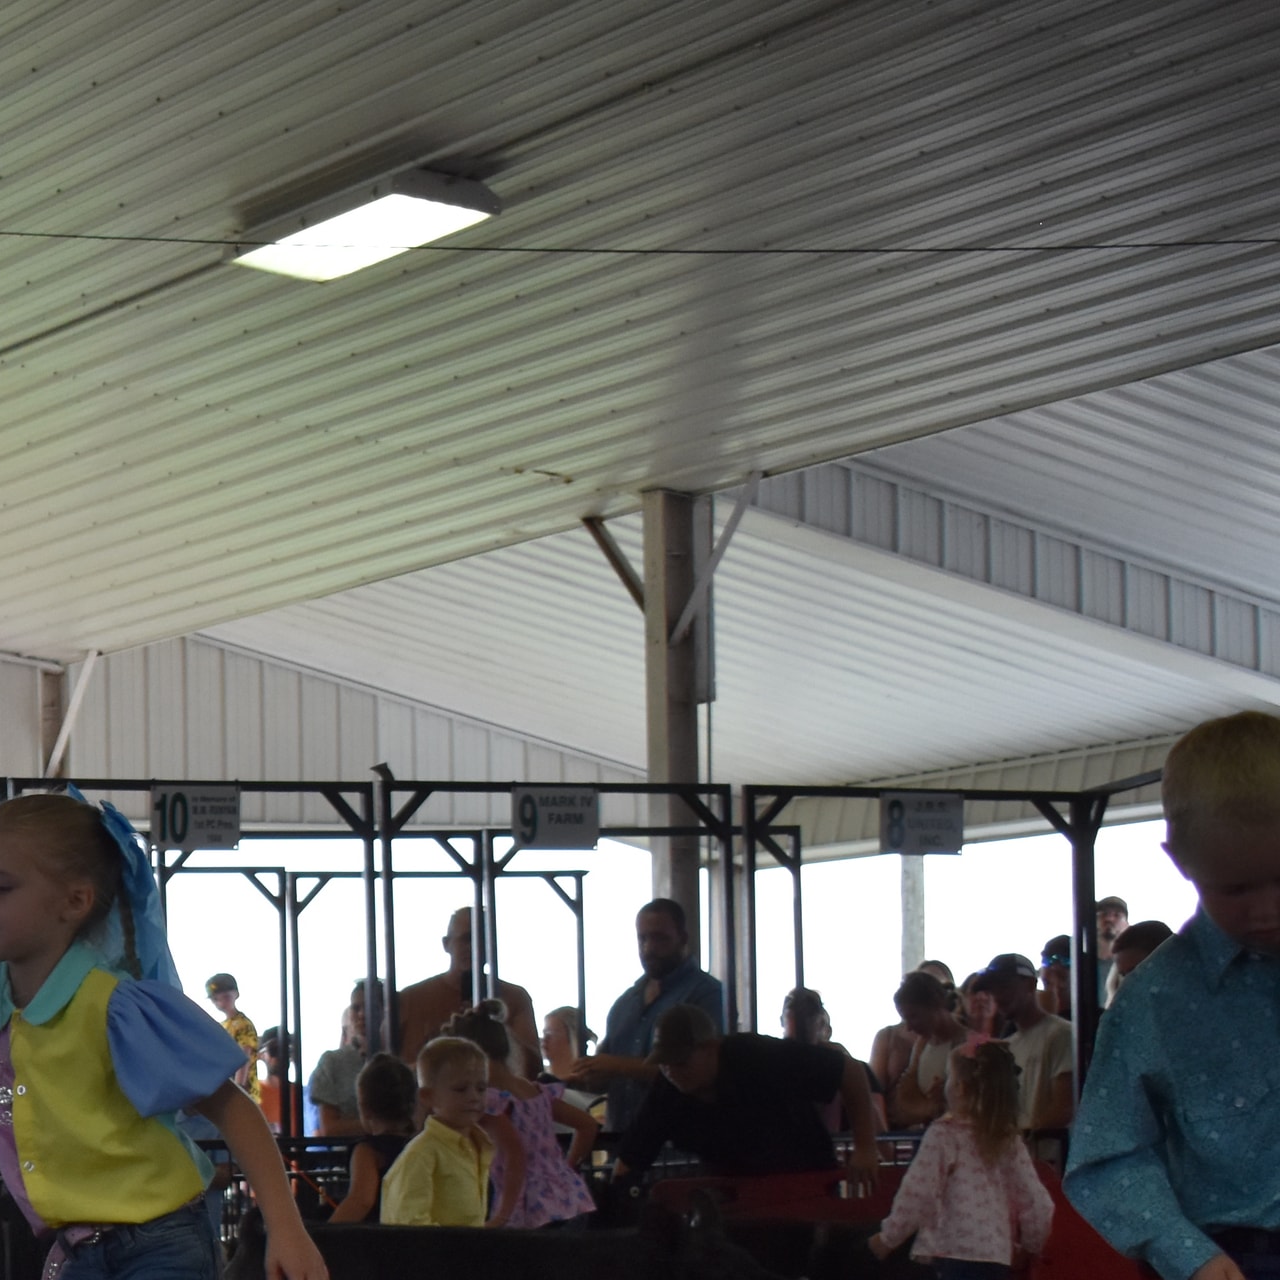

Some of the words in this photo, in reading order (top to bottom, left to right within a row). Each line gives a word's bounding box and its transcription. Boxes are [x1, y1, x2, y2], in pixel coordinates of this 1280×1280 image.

[154, 792, 189, 844] 10
[519, 794, 537, 844] 9
[539, 796, 576, 807] MARK
[580, 796, 593, 808] IV
[548, 812, 584, 824] FARM
[887, 799, 905, 849] 8
